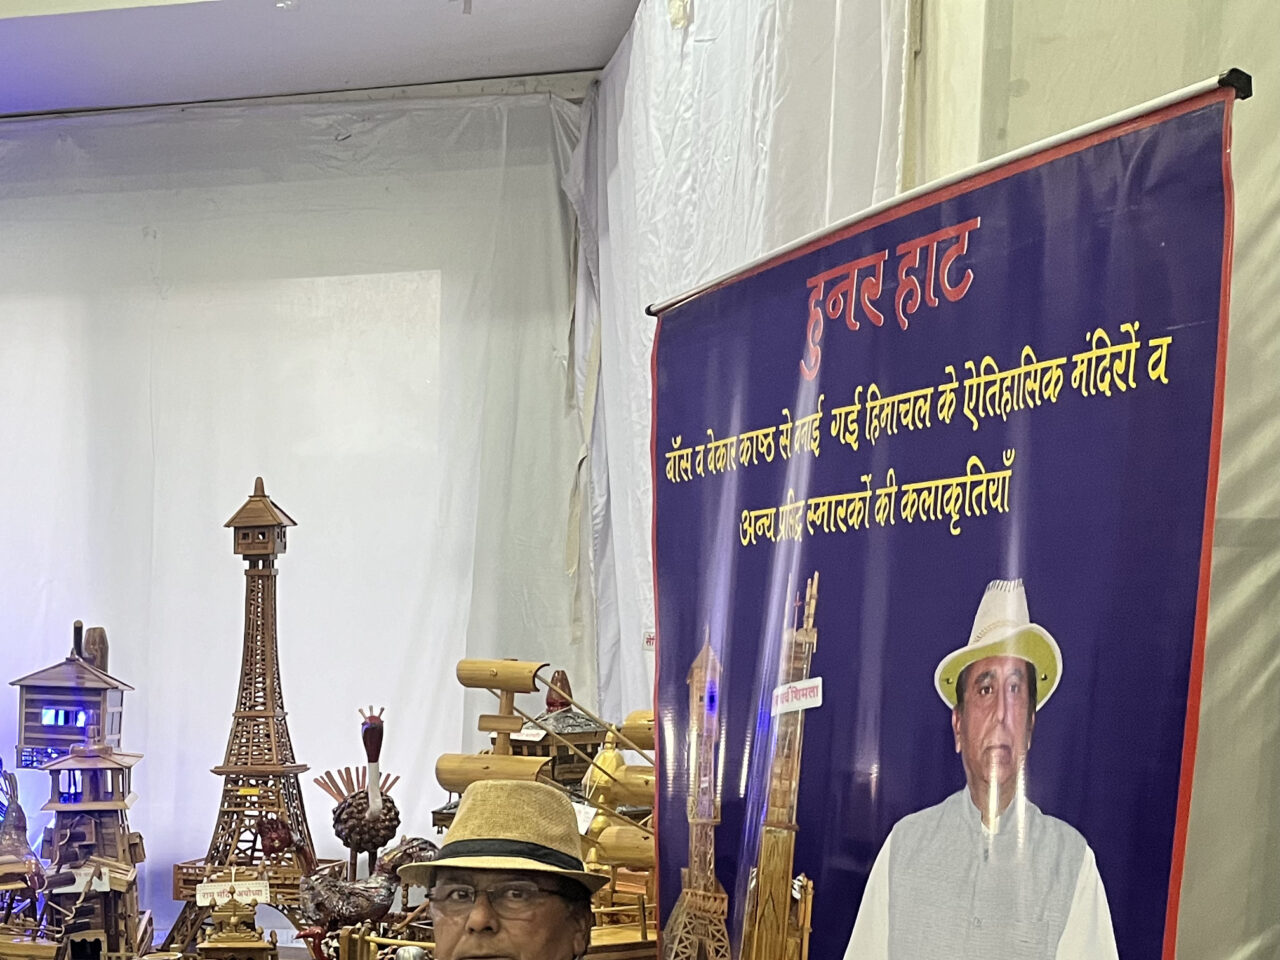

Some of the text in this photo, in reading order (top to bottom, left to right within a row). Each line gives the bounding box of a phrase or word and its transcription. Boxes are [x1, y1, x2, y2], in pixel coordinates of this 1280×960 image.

[800, 216, 980, 381] हुनर हाट
[695, 444, 705, 478] व
[739, 426, 776, 467] काष्ठ
[779, 408, 793, 460] से
[831, 386, 863, 451] गई
[865, 383, 934, 446] हिमाचल
[937, 365, 959, 424] के
[963, 345, 1068, 431] ऐतिहासिक
[1071, 321, 1141, 397] मंदिरों
[1148, 336, 1173, 384] व
[740, 508, 776, 546] अन्य
[807, 474, 872, 536] स्मारकों
[874, 468, 898, 527] की
[900, 448, 1016, 535] कलाकृतियाँ
[216, 888, 230, 899] मंदि
